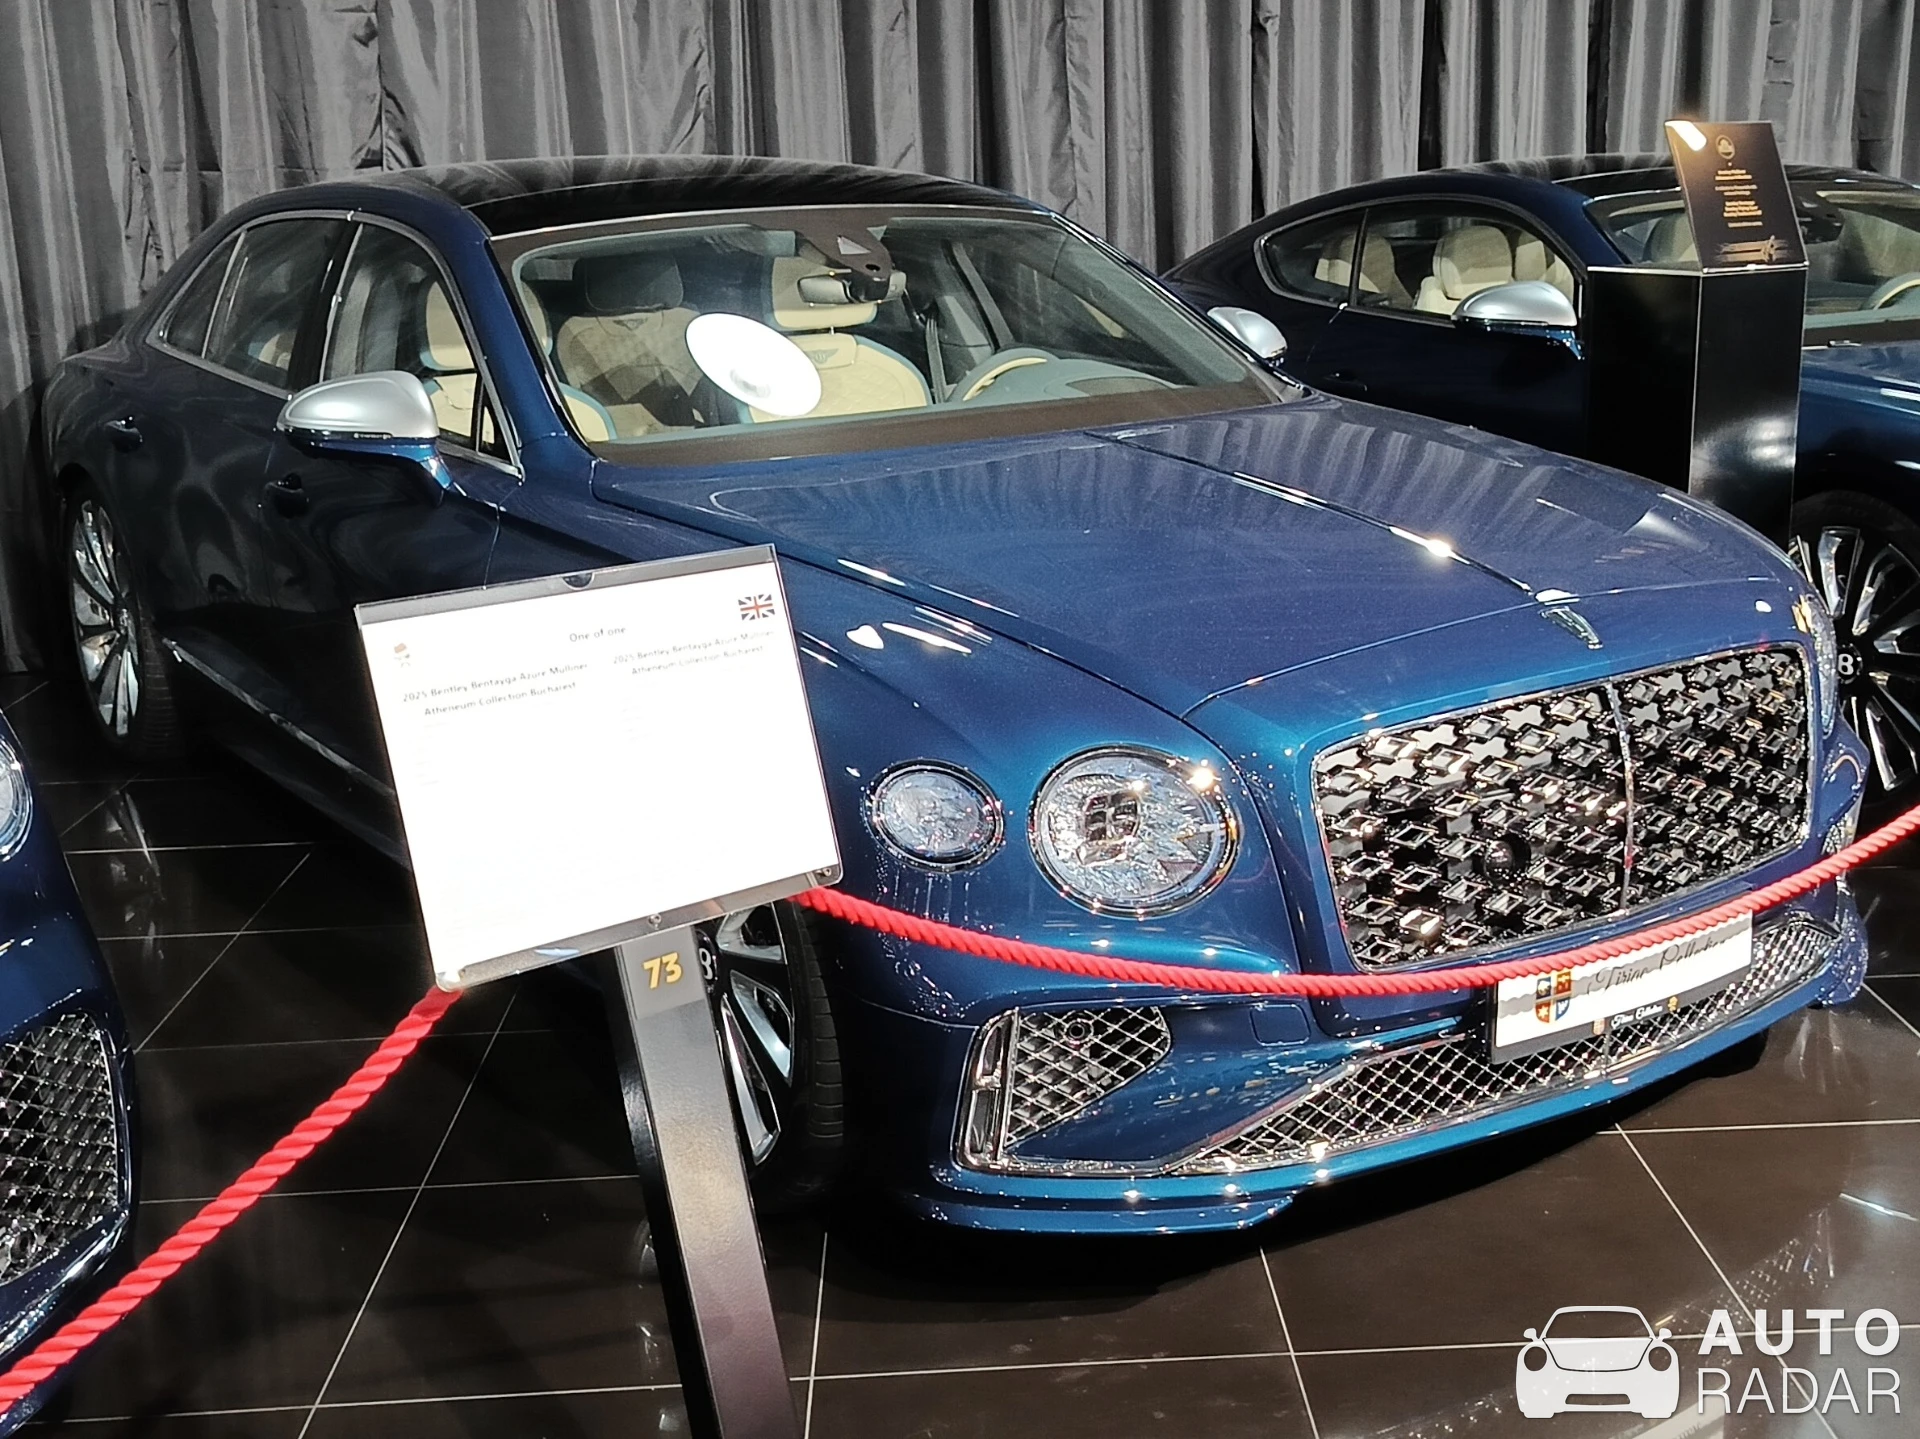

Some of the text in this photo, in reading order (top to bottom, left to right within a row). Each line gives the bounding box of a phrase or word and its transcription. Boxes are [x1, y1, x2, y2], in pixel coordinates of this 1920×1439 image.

[569, 625, 627, 643] One of one
[637, 648, 670, 660] Bentley
[1838, 653, 1855, 675] B
[403, 663, 588, 702] 2025 Bentley Bentayga Azure Mulliner
[424, 681, 577, 716] Atheneum Collection Bucharest
[643, 951, 683, 991] 73
